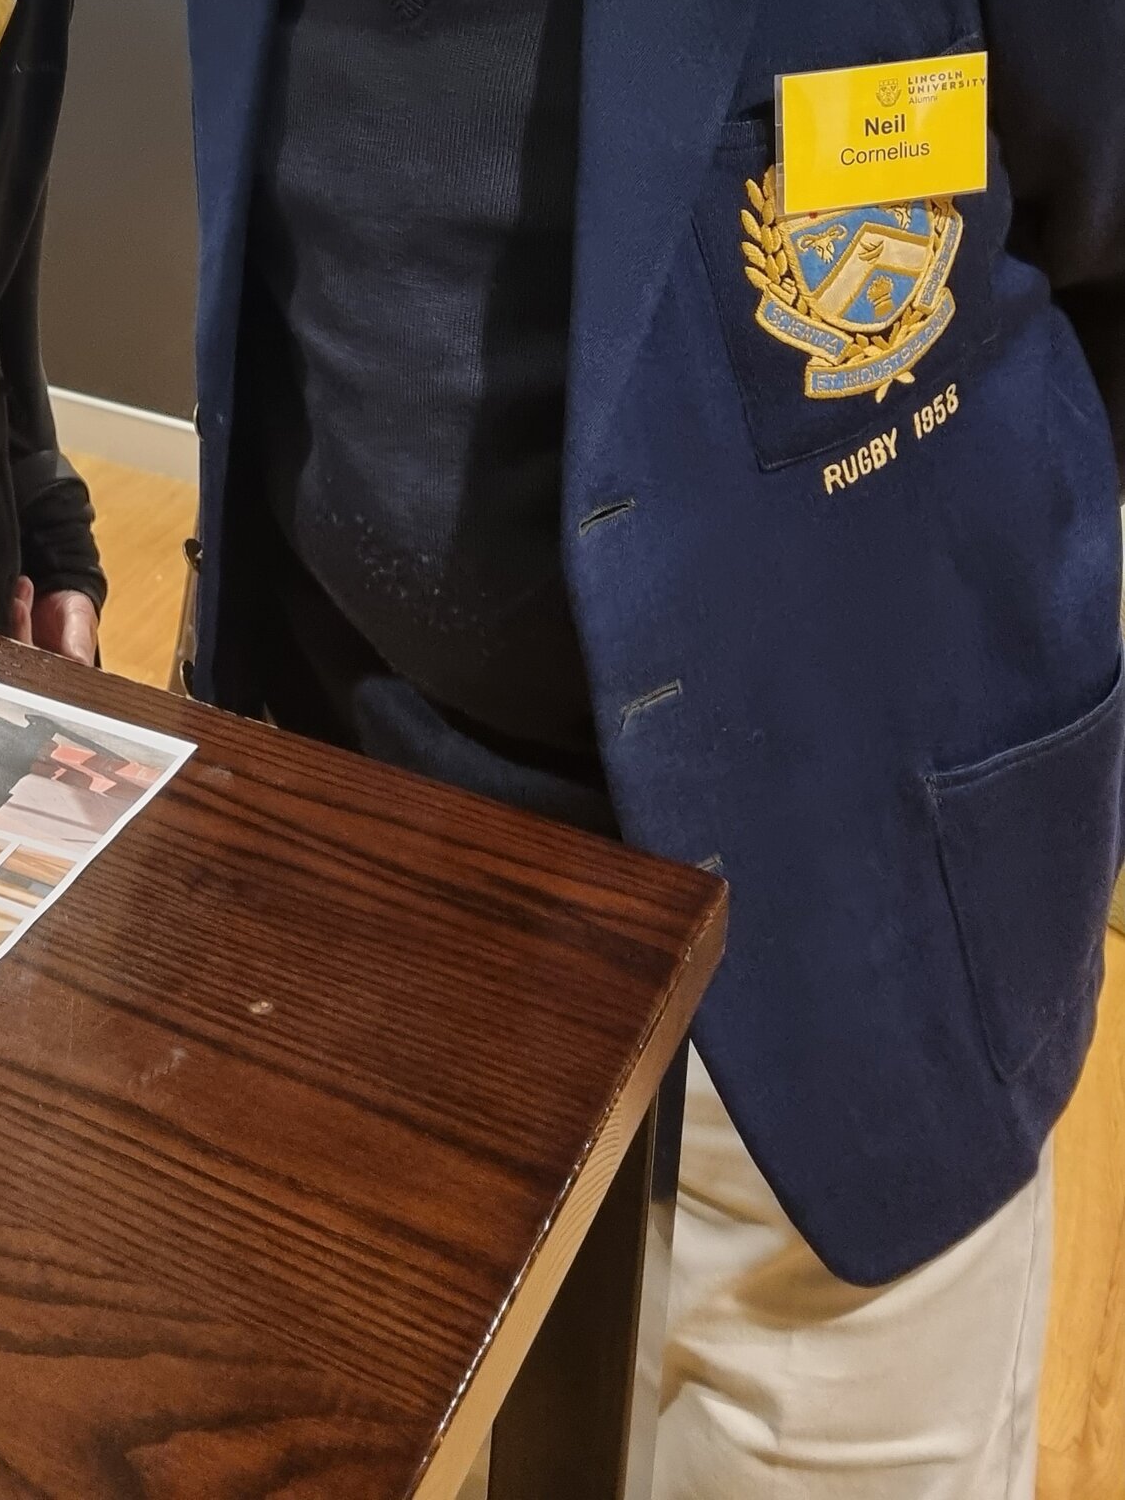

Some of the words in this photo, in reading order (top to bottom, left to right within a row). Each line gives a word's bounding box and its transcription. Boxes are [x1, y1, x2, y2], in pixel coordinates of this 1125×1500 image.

[907, 70, 963, 85] LINCOLN
[907, 77, 987, 95] UNIVERSITY
[908, 94, 939, 105] Alumni
[864, 113, 906, 137] Neil
[840, 141, 931, 166] Cornelius
[823, 426, 898, 495] RUGBY
[913, 382, 959, 439] 1958
